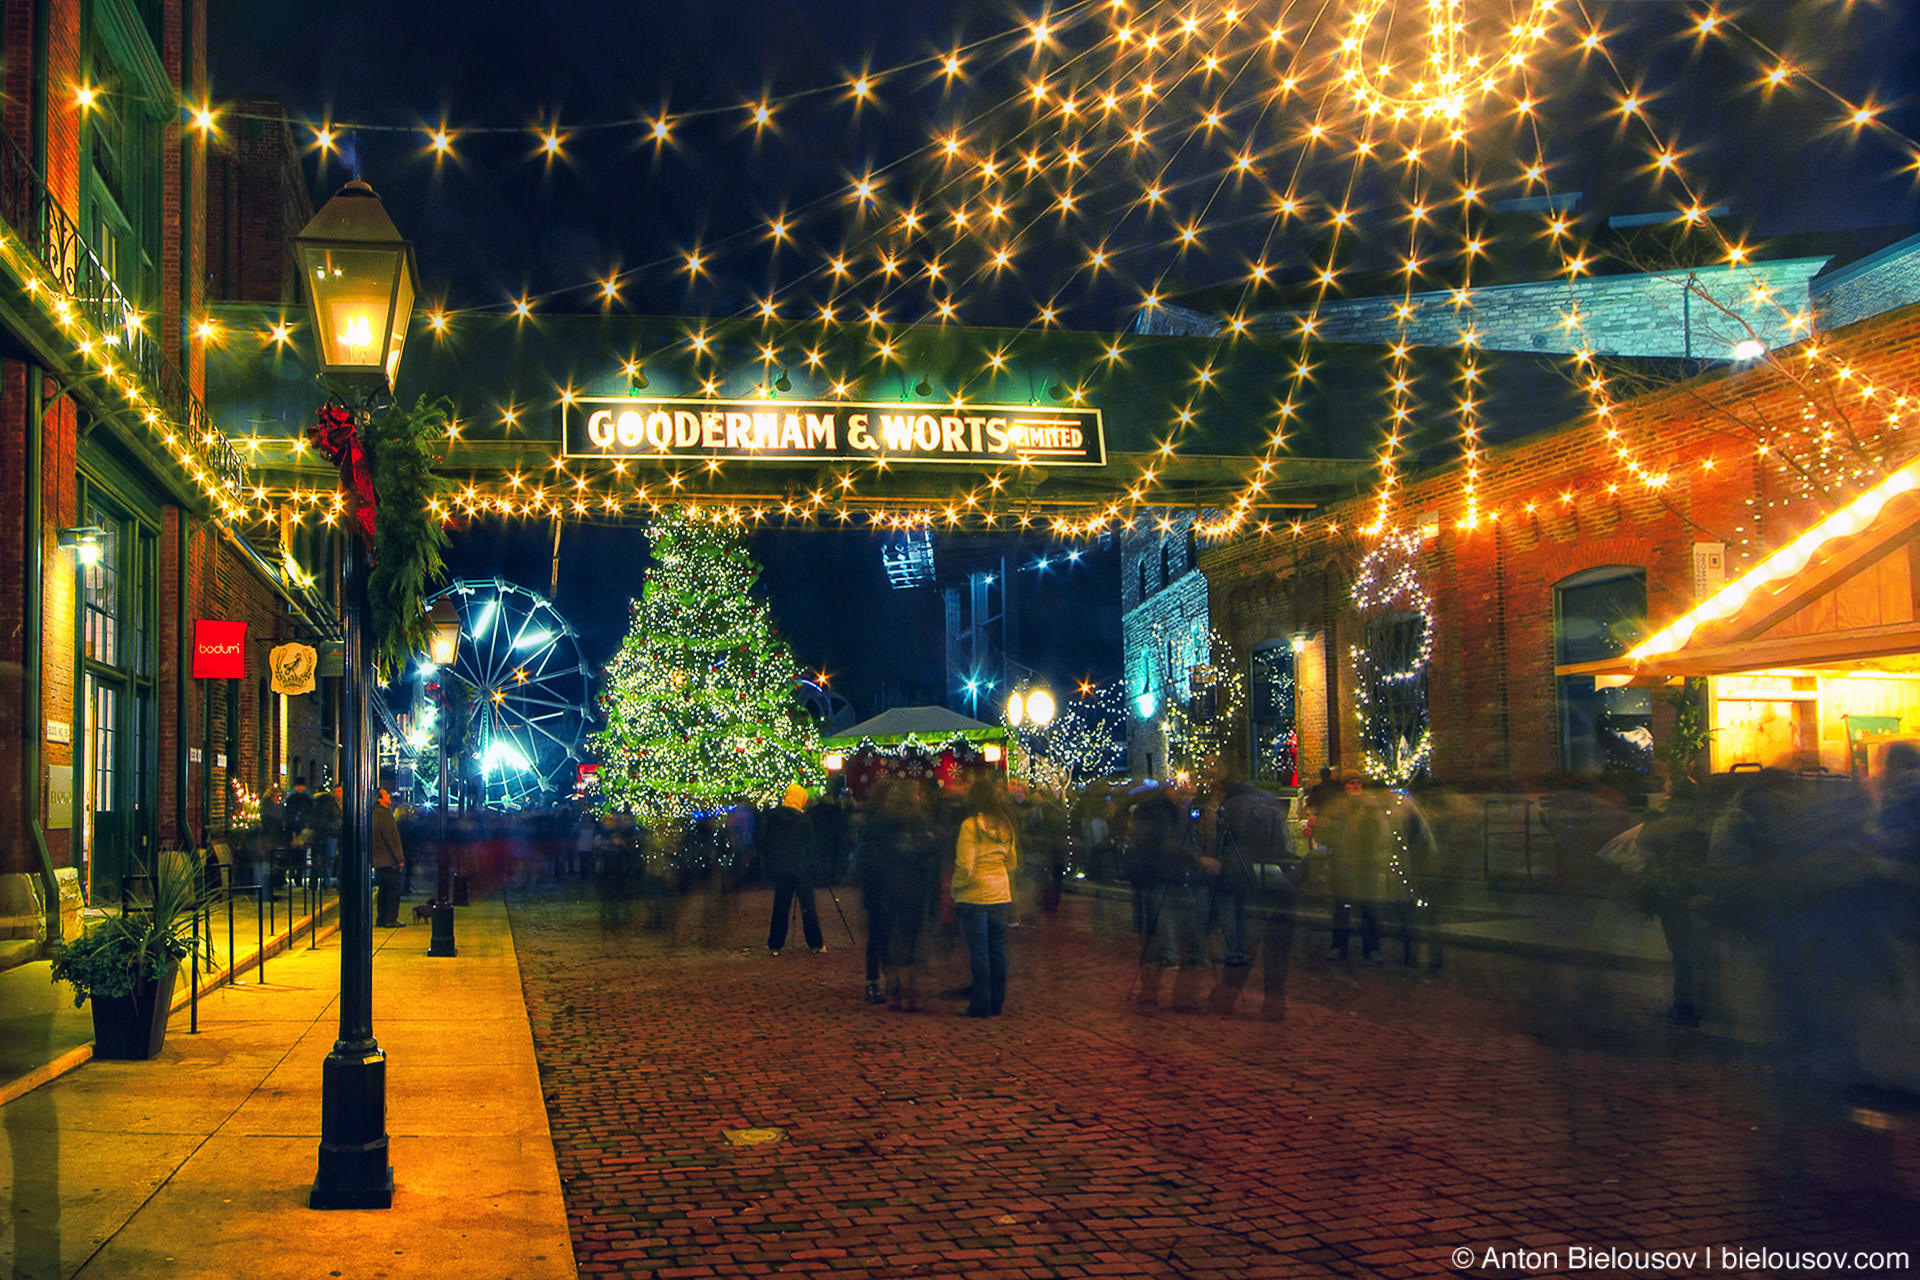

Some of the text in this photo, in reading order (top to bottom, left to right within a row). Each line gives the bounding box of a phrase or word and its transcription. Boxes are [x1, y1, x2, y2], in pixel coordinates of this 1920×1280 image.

[587, 409, 1012, 454] GOODERHAM & WORTS
[199, 643, 240, 655] bodum
